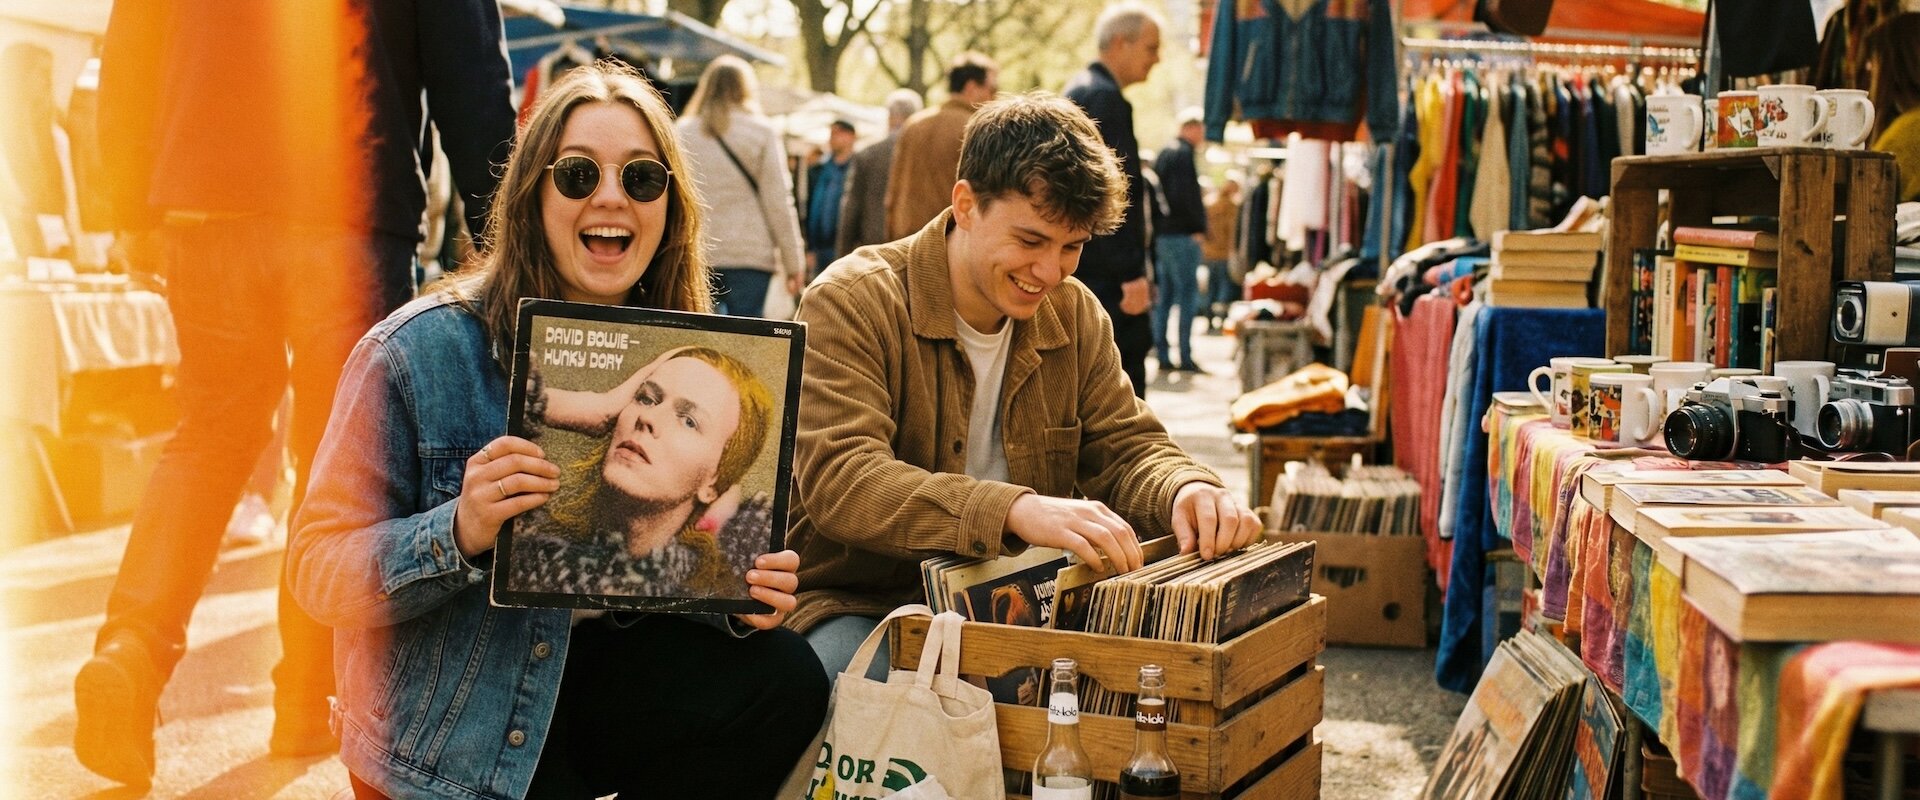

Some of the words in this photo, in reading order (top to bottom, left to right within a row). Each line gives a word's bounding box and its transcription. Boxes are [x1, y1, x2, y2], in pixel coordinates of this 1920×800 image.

[545, 326, 584, 346] DAVID
[543, 348, 587, 368] HUNKY
[589, 351, 624, 371] DORY
